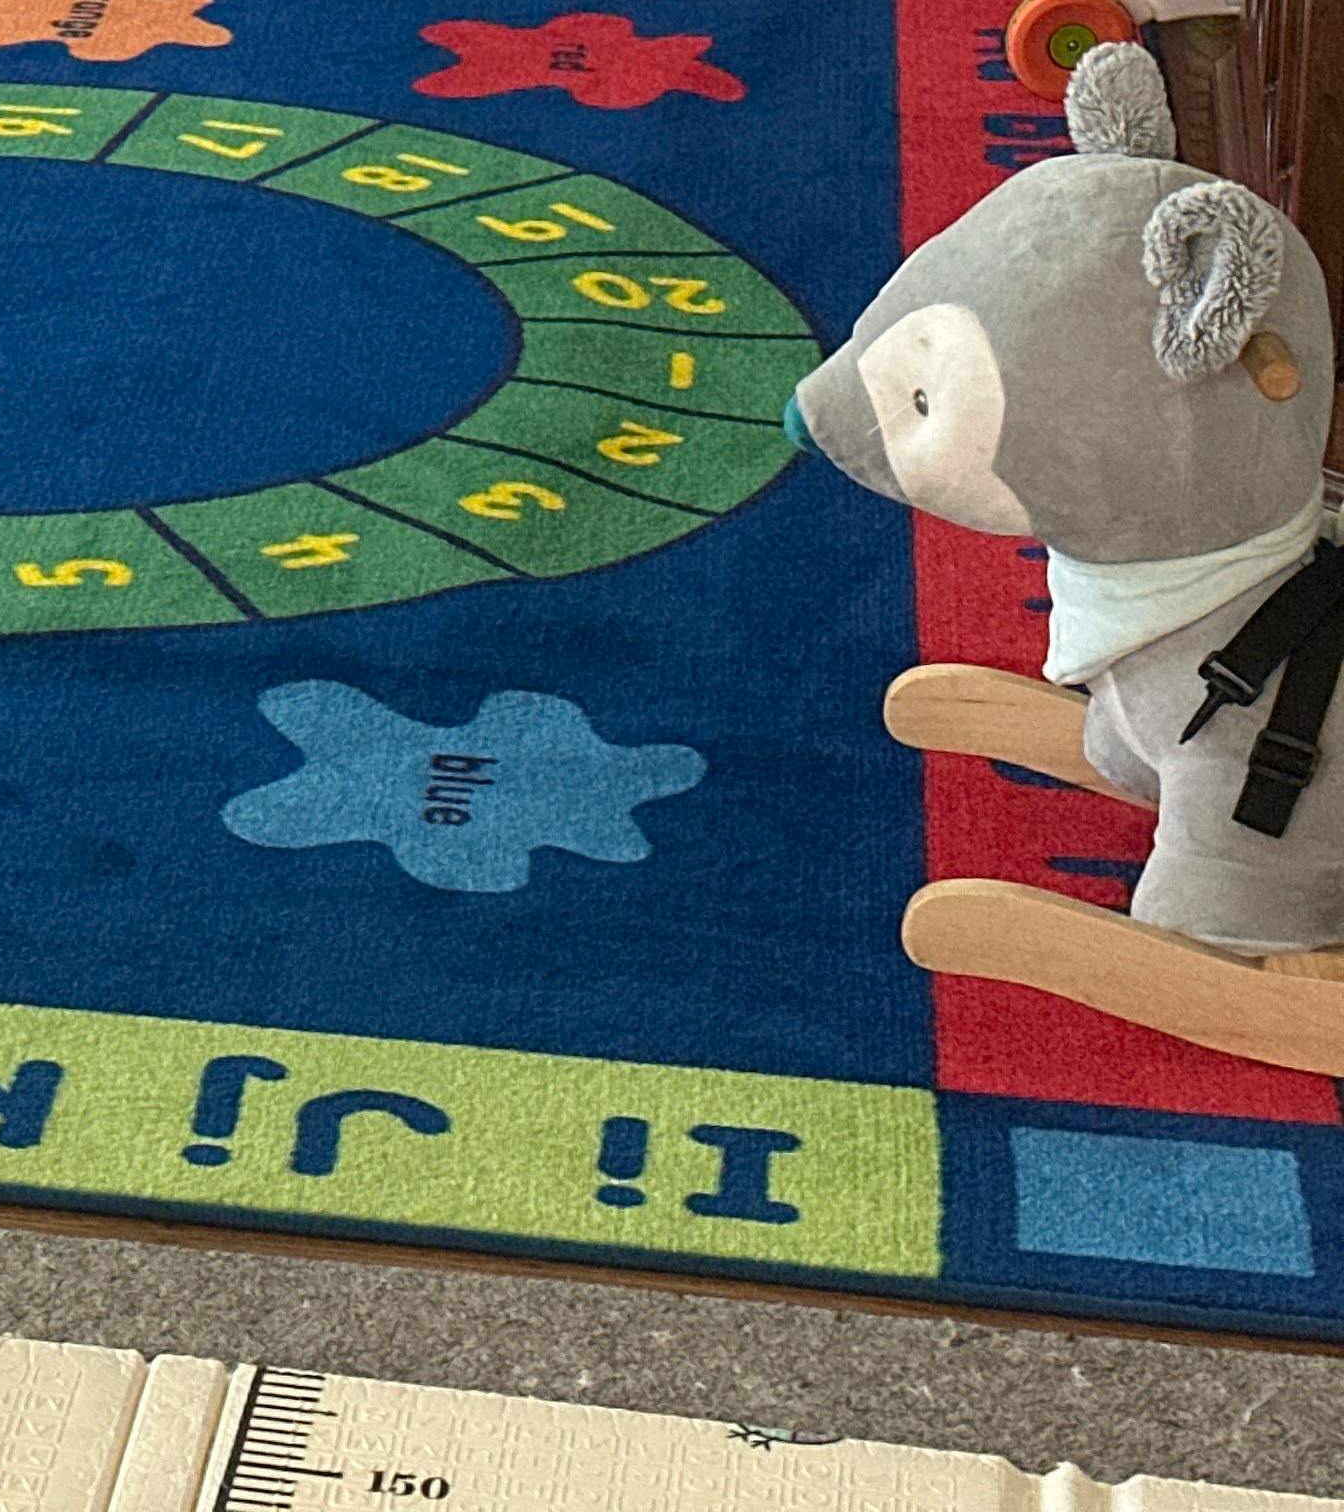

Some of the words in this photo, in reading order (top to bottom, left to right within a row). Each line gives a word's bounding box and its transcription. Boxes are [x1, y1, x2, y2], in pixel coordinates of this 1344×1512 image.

[177, 120, 284, 161] 17
[341, 152, 470, 193] 18
[474, 203, 616, 244] 19
[571, 271, 728, 317] 20
[669, 352, 695, 389] 1
[596, 420, 686, 466] 2
[457, 480, 567, 521] 3
[260, 533, 361, 570] 4
[15, 558, 133, 588] 5
[422, 753, 501, 825] blue
[181, 1055, 452, 1177] Jj
[594, 1115, 803, 1225] Ii
[364, 1468, 450, 1501] 150
